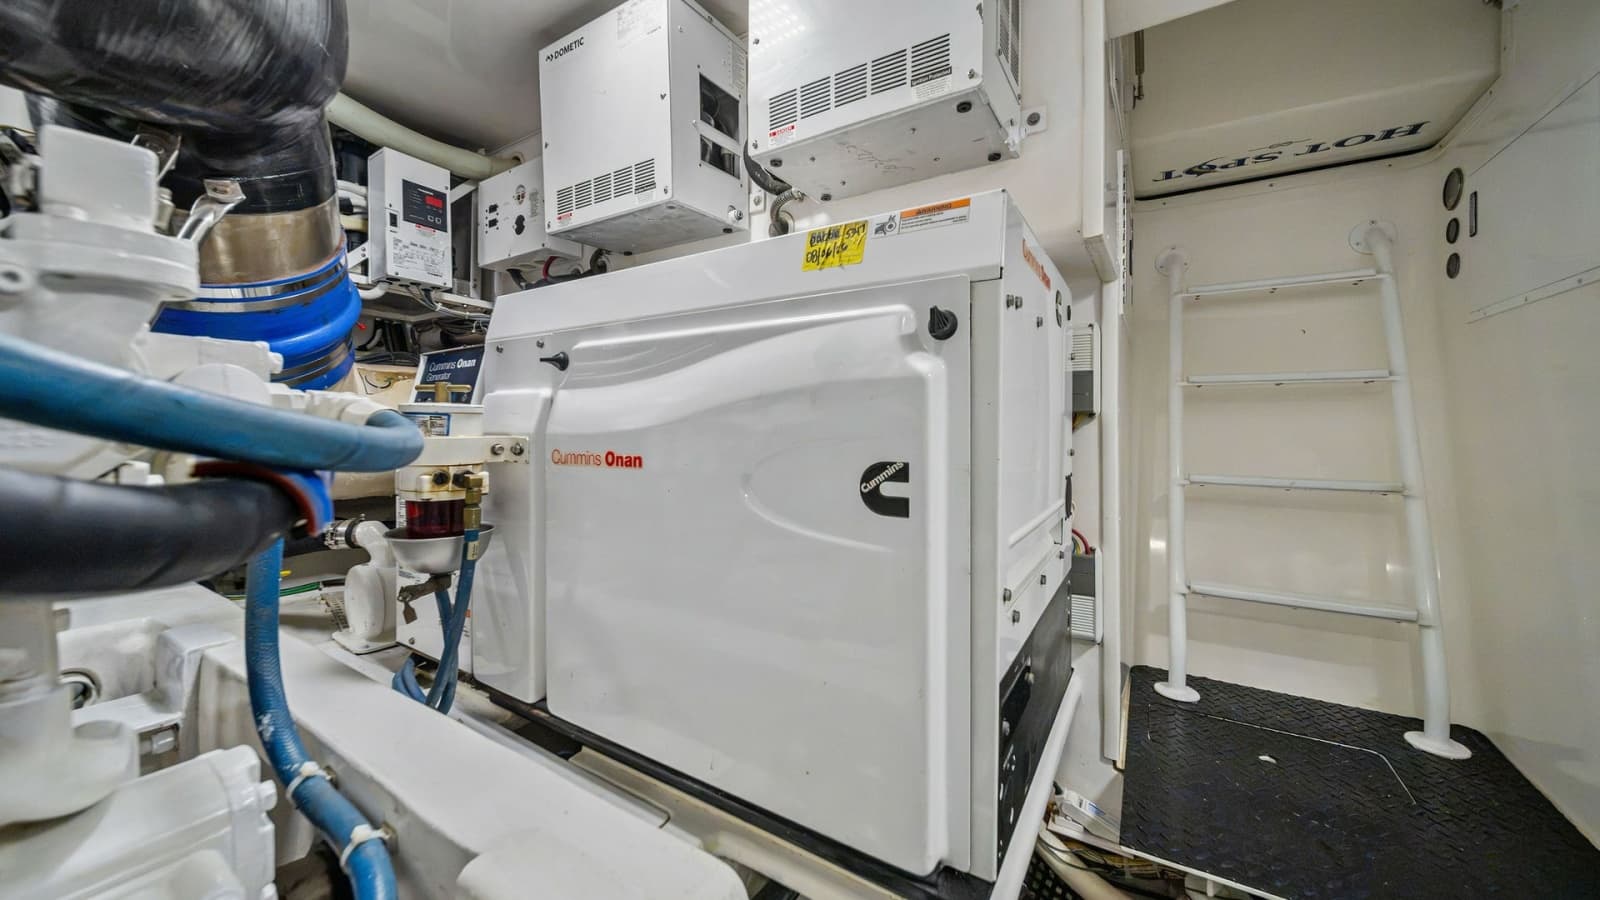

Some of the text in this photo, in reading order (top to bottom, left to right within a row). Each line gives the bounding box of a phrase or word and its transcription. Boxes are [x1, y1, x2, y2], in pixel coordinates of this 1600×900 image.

[554, 36, 584, 60] DOMETIC
[1151, 120, 1431, 182] HOT SPOT
[429, 358, 476, 372] Cummins Onan
[551, 448, 643, 468] Cummins Onan
[861, 461, 904, 493] Cummins
